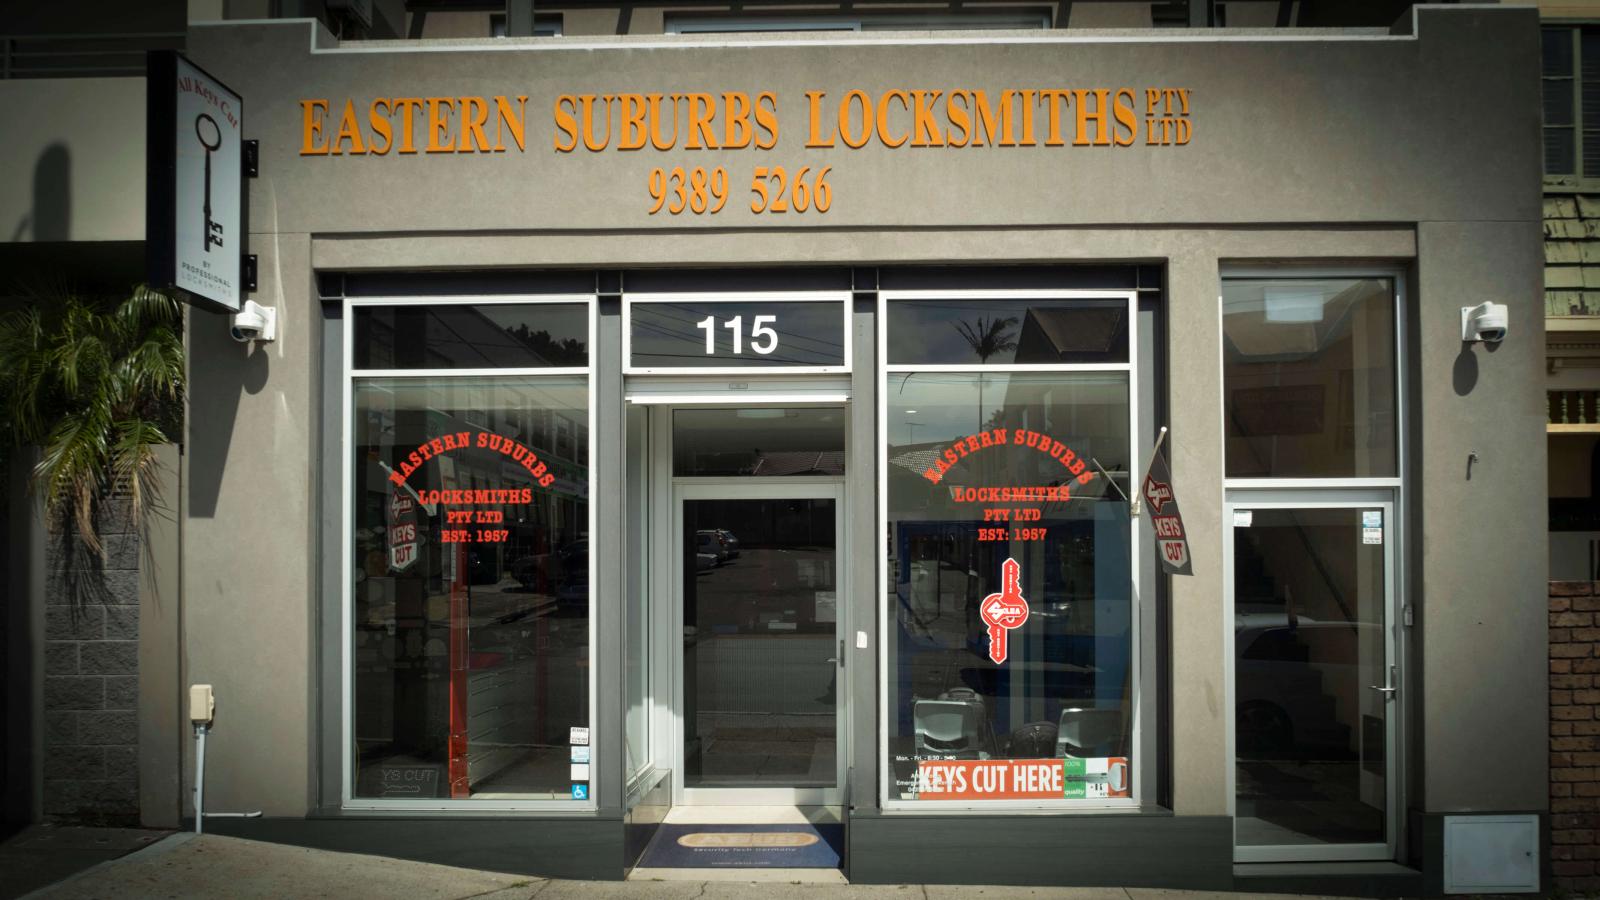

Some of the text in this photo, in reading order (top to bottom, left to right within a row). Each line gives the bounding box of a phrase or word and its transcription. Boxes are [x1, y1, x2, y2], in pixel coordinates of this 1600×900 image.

[178, 76, 238, 129] All Keys Cut
[299, 87, 1192, 155] EASTERN SUBURBS LOCKSMITHS PTY
[1145, 117, 1193, 145] LTD
[648, 165, 833, 215] 9389 5266
[181, 261, 232, 288] PROFESSIONAL
[202, 260, 211, 270] BY
[697, 315, 779, 355] 115
[388, 431, 555, 488] EASTERN SUBURBS
[922, 429, 1094, 486] EASTERN SUBURBS
[418, 488, 532, 505] LOCKSMITHS
[953, 485, 1071, 503] LOCKSMITHS
[447, 510, 504, 524] PTY LTD
[983, 508, 1041, 522] PTY LTD
[392, 524, 416, 544] KEYS
[440, 529, 509, 543] EST: 1957
[977, 527, 1047, 541] EST: 1957
[1154, 517, 1181, 537] KEYS
[394, 546, 412, 564] CUT
[1165, 542, 1183, 561] CUT
[404, 769, 435, 781] CUT
[919, 764, 1063, 793] KEYS CUT HERE
[1064, 788, 1085, 797] quality
